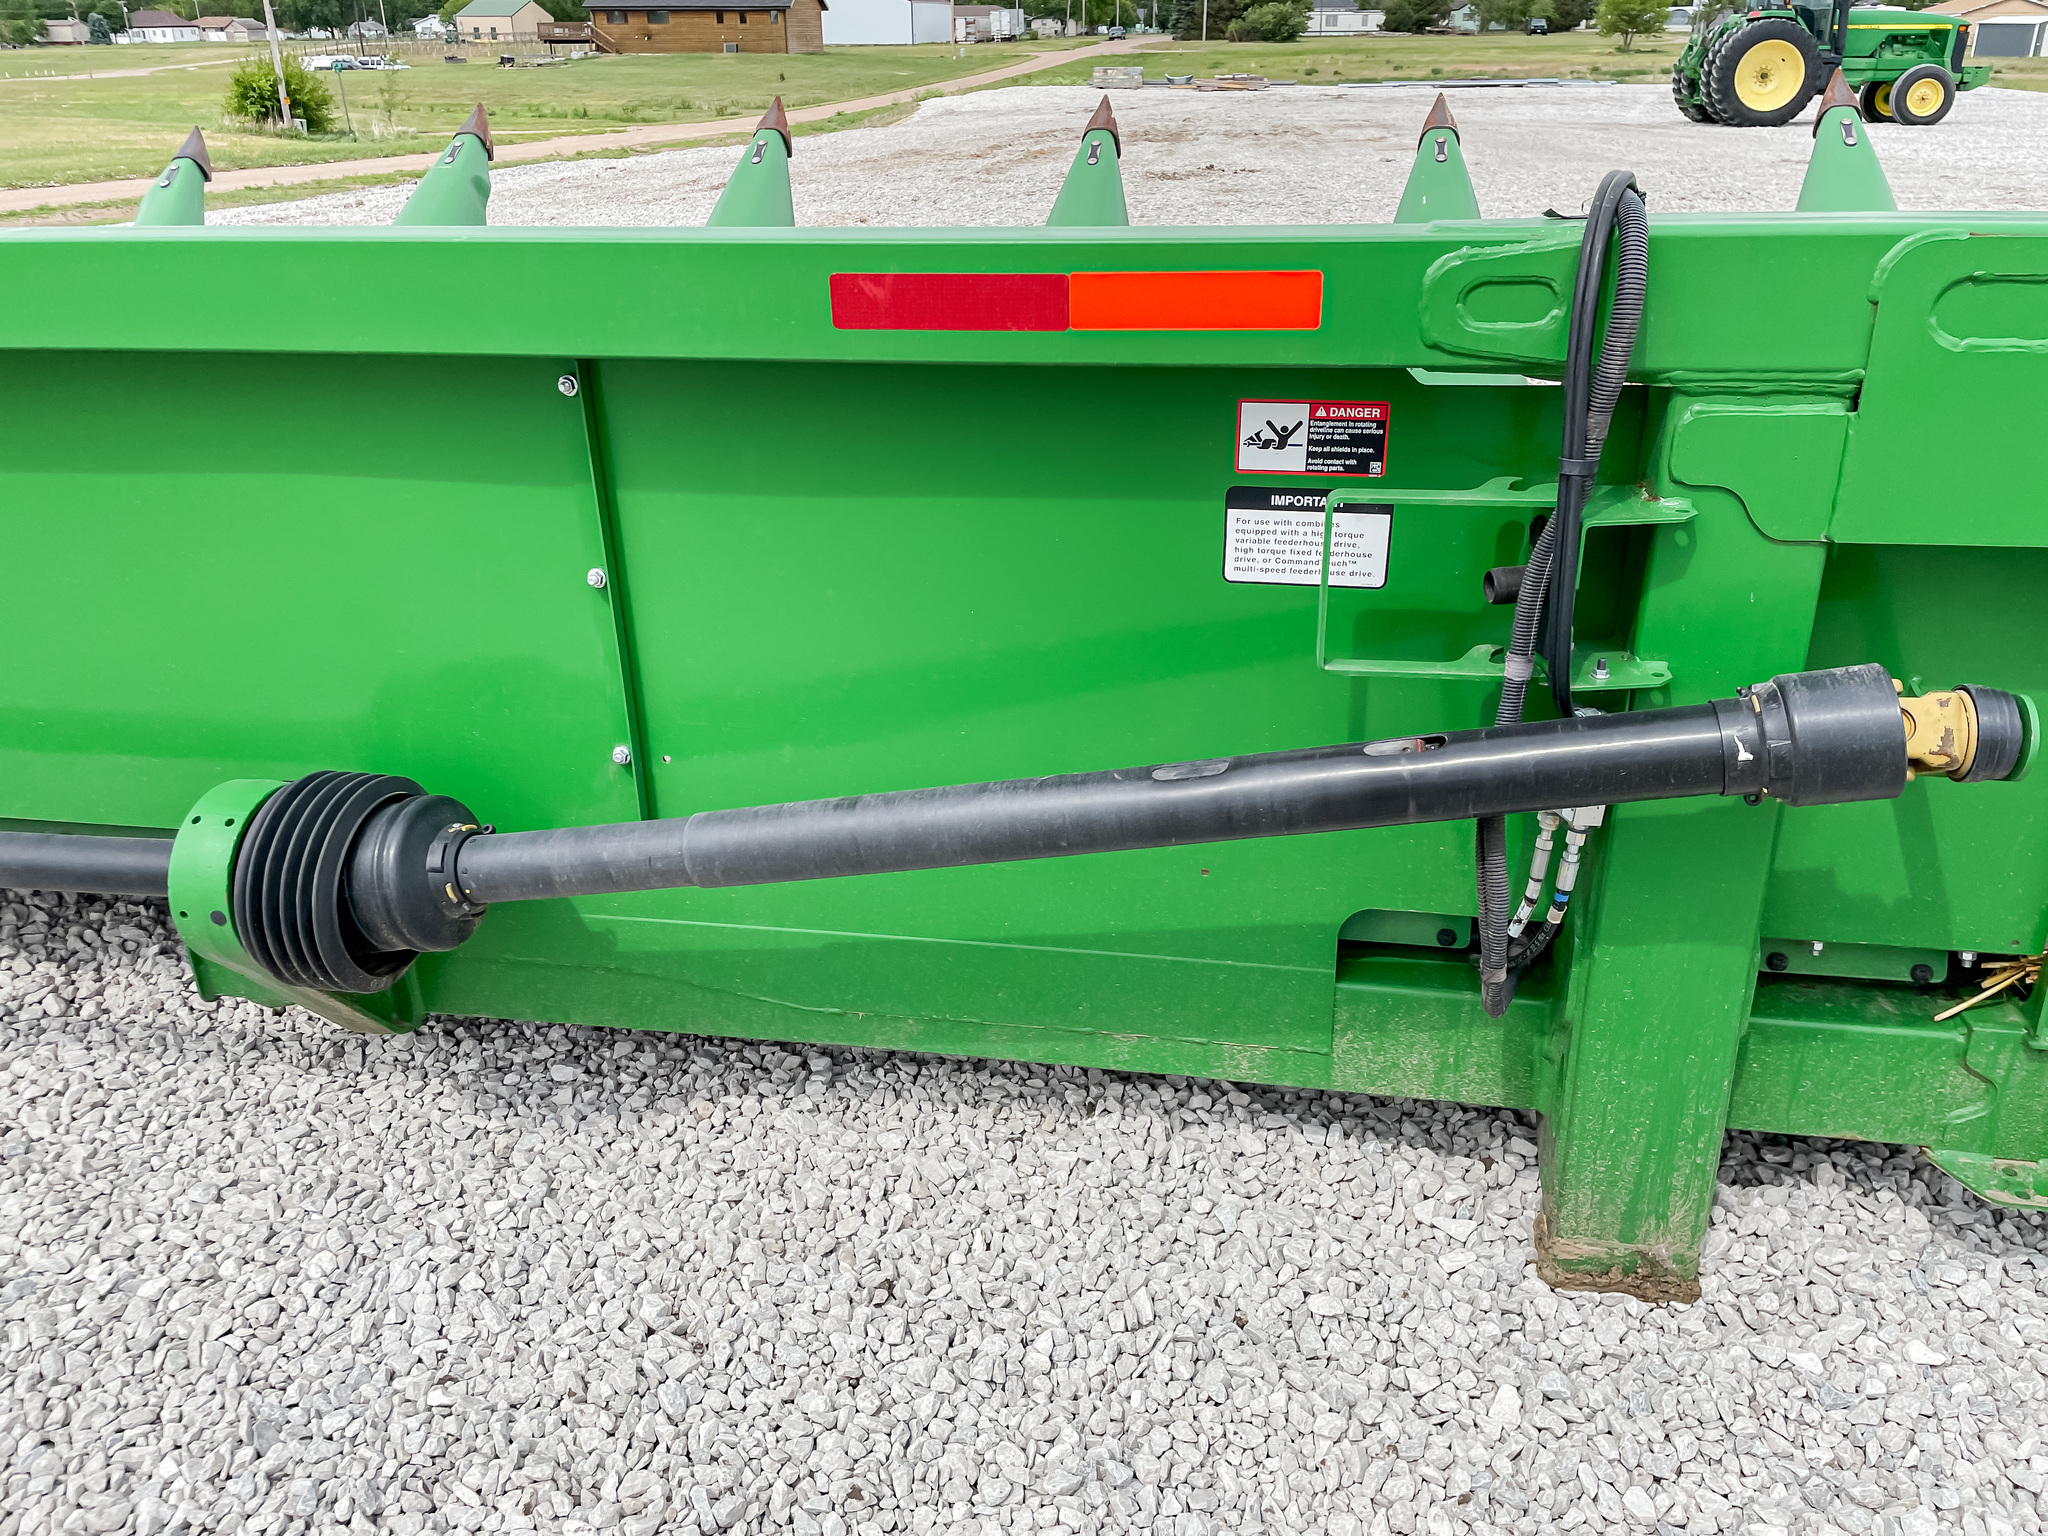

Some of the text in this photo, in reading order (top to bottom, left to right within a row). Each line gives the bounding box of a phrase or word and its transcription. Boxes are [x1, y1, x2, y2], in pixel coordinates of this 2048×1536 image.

[1330, 407, 1380, 418] DANGER
[1271, 494, 1344, 508] IMPORTA
[1296, 520, 1340, 528] combies
[1235, 528, 1277, 536] equipped
[1311, 530, 1324, 539] hig
[1334, 532, 1364, 540] torque
[1274, 538, 1324, 547] feederhous
[1334, 541, 1360, 549] drive,
[1234, 546, 1254, 554] high
[1316, 550, 1372, 558] federhouse
[1234, 556, 1260, 564] drive,
[1234, 566, 1286, 574] multi-speed
[1290, 567, 1346, 576] feederhuse
